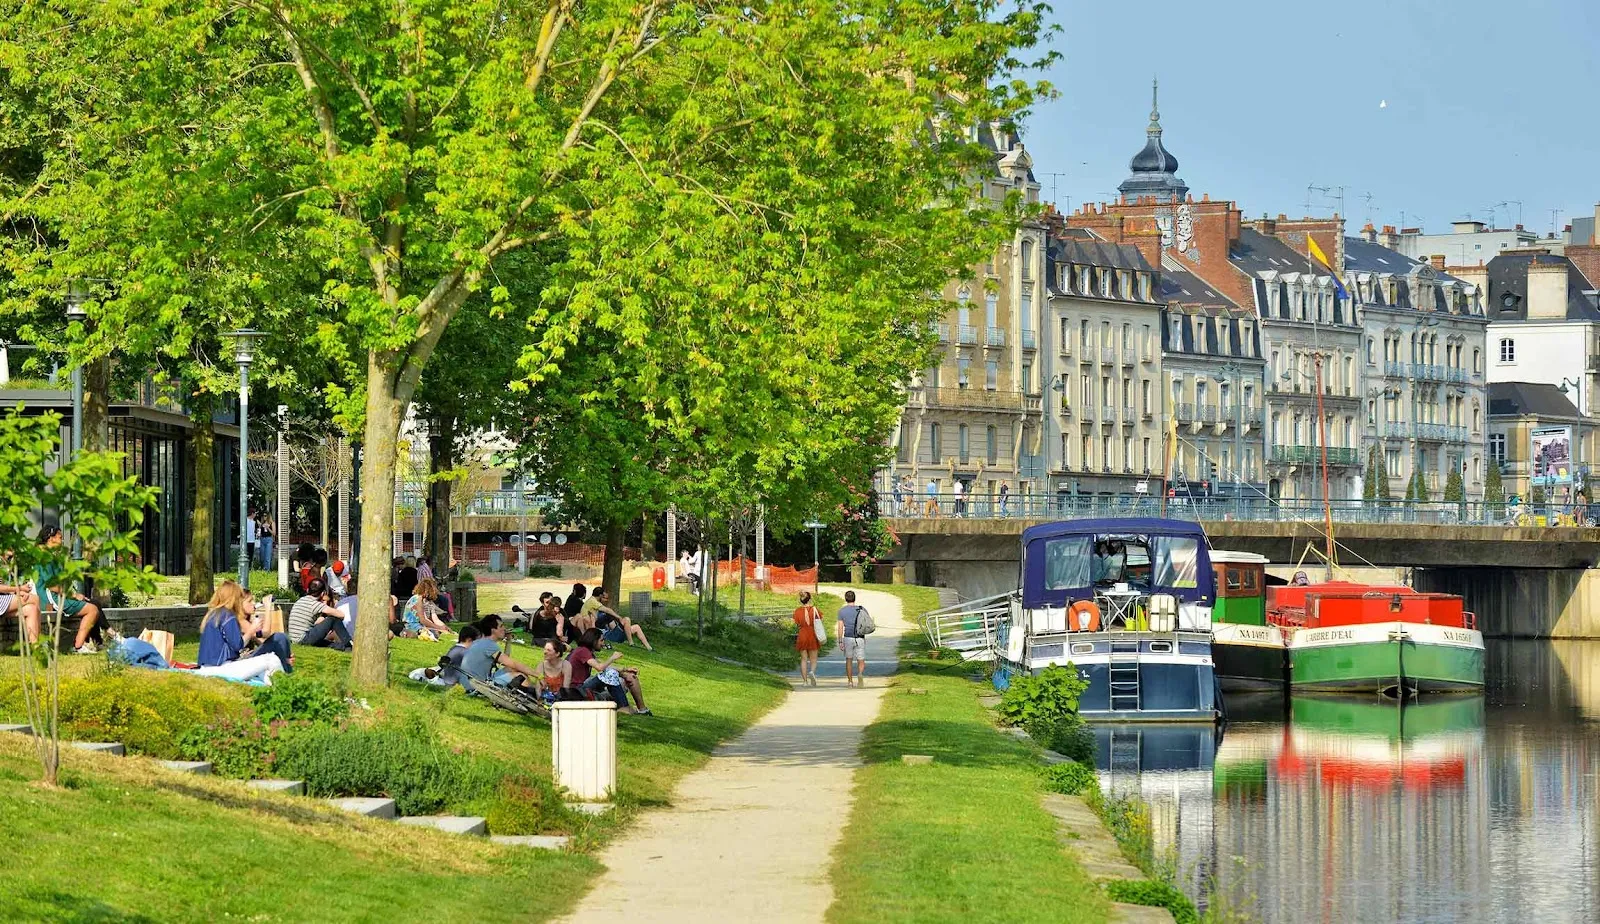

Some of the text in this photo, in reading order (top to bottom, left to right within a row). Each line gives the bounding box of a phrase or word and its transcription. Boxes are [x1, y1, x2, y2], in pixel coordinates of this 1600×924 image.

[1240, 629, 1251, 639] NA
[1331, 629, 1352, 639] D'EAU
[1443, 631, 1454, 641] NA
